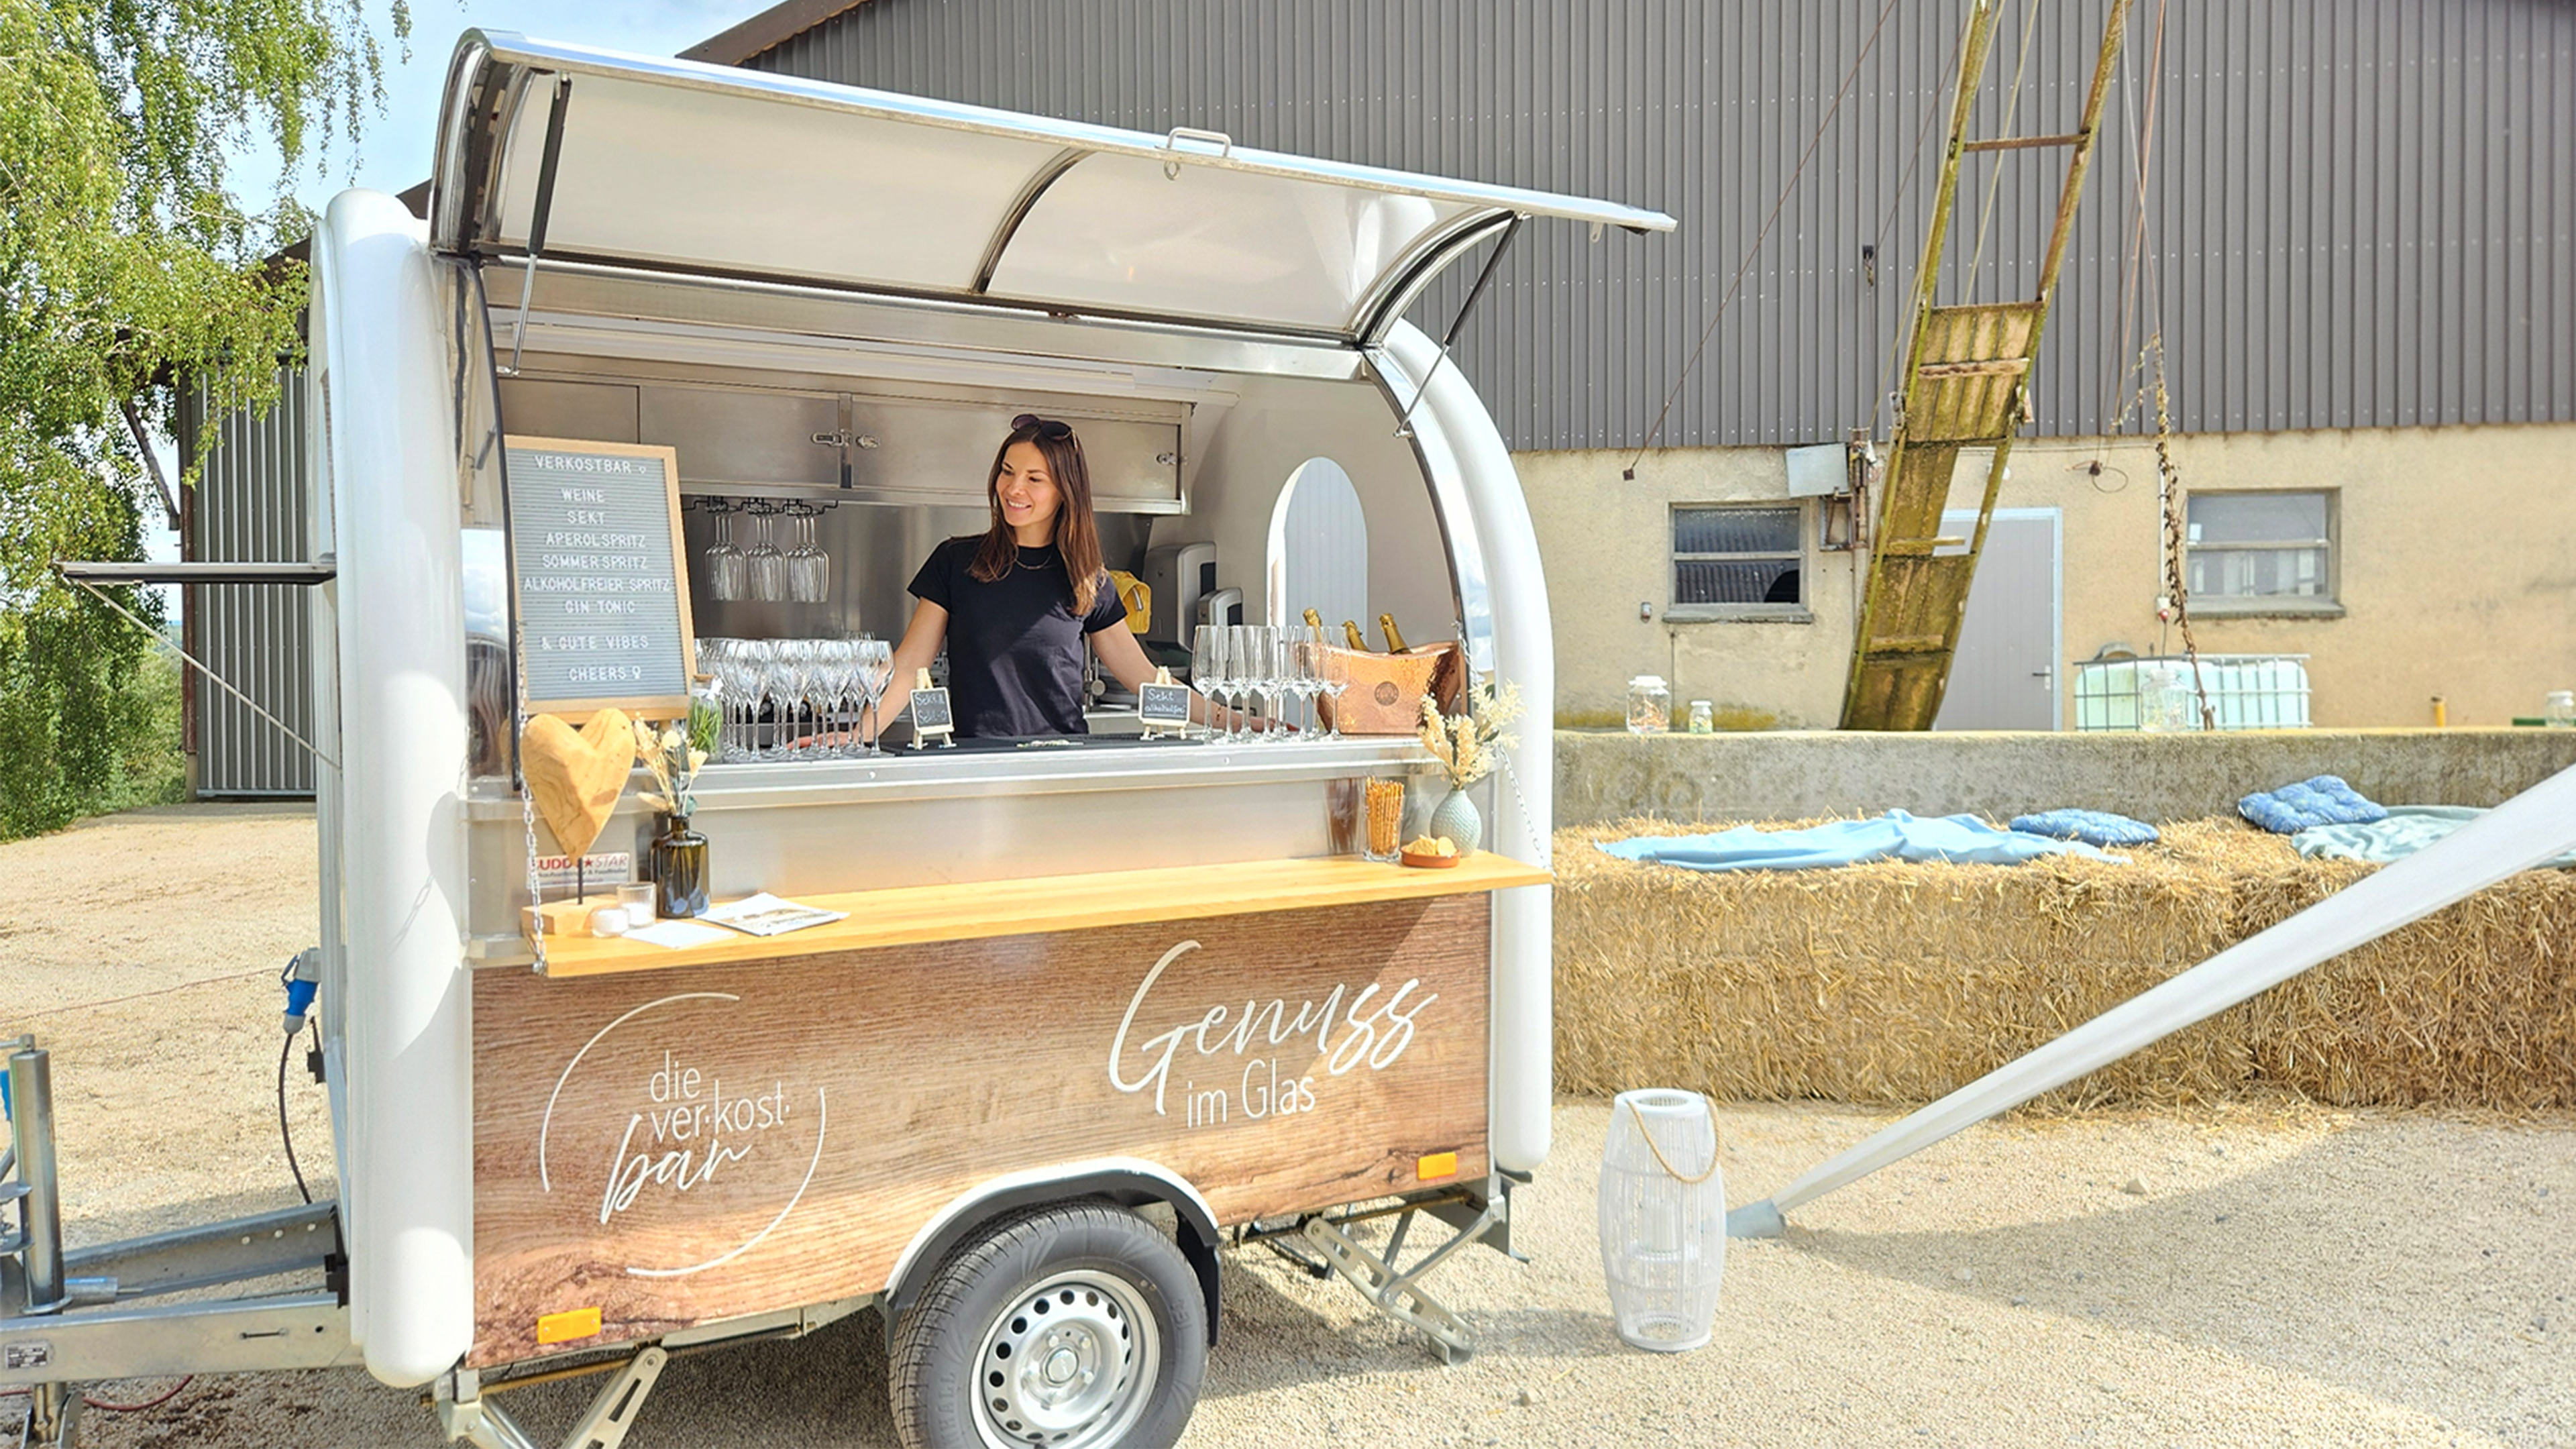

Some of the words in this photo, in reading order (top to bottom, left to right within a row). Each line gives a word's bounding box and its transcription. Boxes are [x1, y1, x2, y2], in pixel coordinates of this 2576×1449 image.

[534, 455, 632, 474] VERKOSTBAR
[561, 488, 605, 503] WEINE
[567, 511, 604, 525] SEKT
[523, 577, 623, 592] ALKOHOLFREIER
[629, 578, 671, 592] SPRITZ
[564, 600, 590, 614] GIN
[596, 600, 636, 614] TONIC
[539, 637, 553, 650] &
[557, 636, 597, 650] GUTE
[604, 635, 649, 649] VIBES
[569, 666, 627, 682] CHEERS
[595, 854, 627, 867] STAR
[1108, 939, 1439, 1115] Genuss
[649, 1049, 702, 1103] die
[1187, 1081, 1228, 1129] im
[1242, 1057, 1316, 1119] Glas
[600, 1113, 753, 1225] bar
